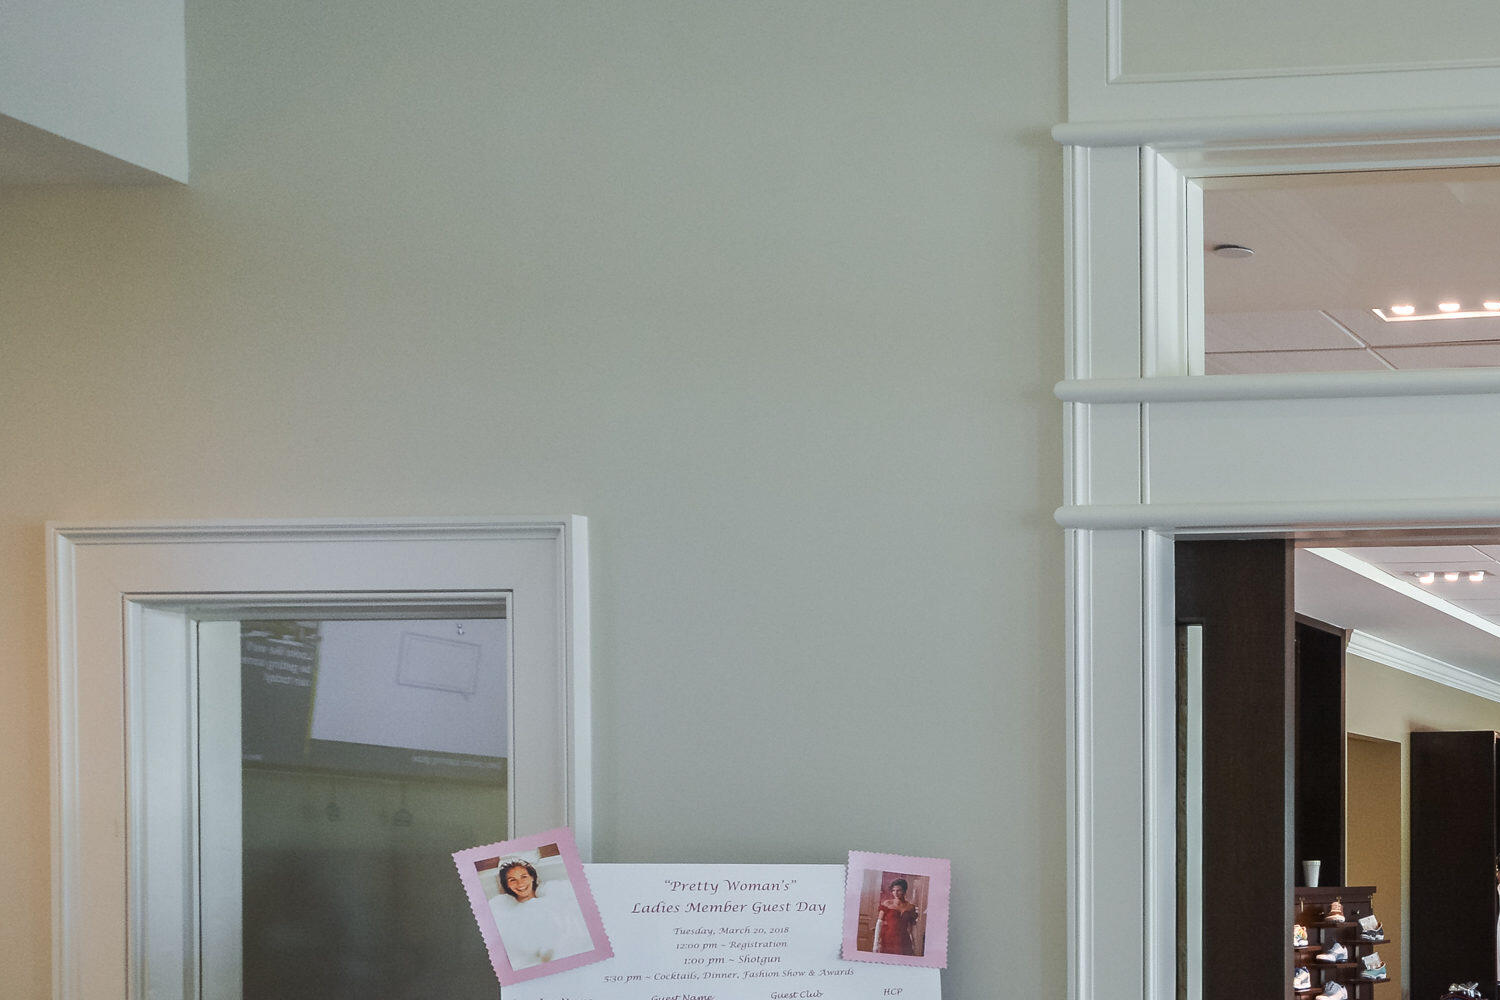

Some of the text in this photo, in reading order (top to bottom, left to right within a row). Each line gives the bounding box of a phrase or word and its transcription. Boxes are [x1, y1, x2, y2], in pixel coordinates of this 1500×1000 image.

[631, 901, 826, 915] Ladies Member Guest Day
[674, 927, 715, 936] Tuesday,
[718, 926, 750, 934] March
[769, 926, 790, 934] 2018
[702, 943, 717, 951] pm
[729, 940, 787, 950] Registration
[684, 957, 704, 965] 1:00
[708, 957, 725, 966] pm
[738, 954, 781, 965] Shotgun
[626, 974, 642, 983] pm
[653, 971, 700, 981] Cocktails,
[703, 970, 740, 980] Dinner,
[742, 970, 779, 980] Fashion
[782, 970, 806, 978] Show
[819, 968, 855, 977] Awards
[770, 989, 824, 1000] Guest Club
[883, 988, 903, 996] HCP
